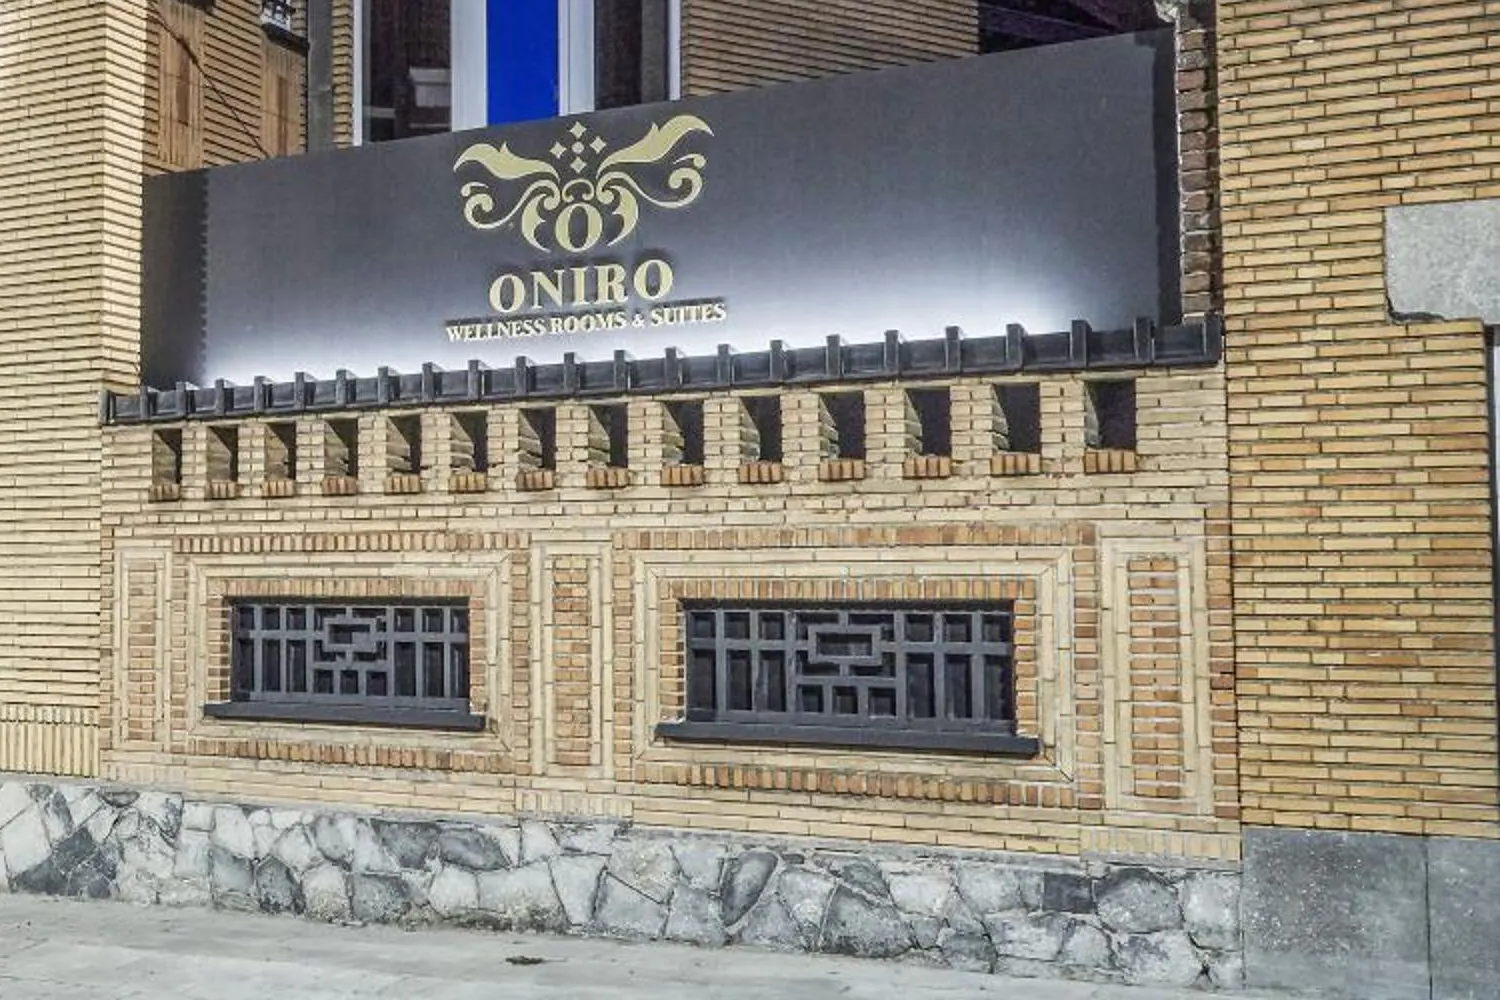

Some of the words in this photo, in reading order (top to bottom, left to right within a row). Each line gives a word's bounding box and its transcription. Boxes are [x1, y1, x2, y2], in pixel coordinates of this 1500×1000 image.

[555, 202, 602, 252] O
[489, 259, 674, 312] ONIRO
[446, 319, 546, 342] WELLNESS
[550, 310, 626, 334] ROOMS
[631, 312, 646, 328] &
[651, 303, 727, 326] SUITES
